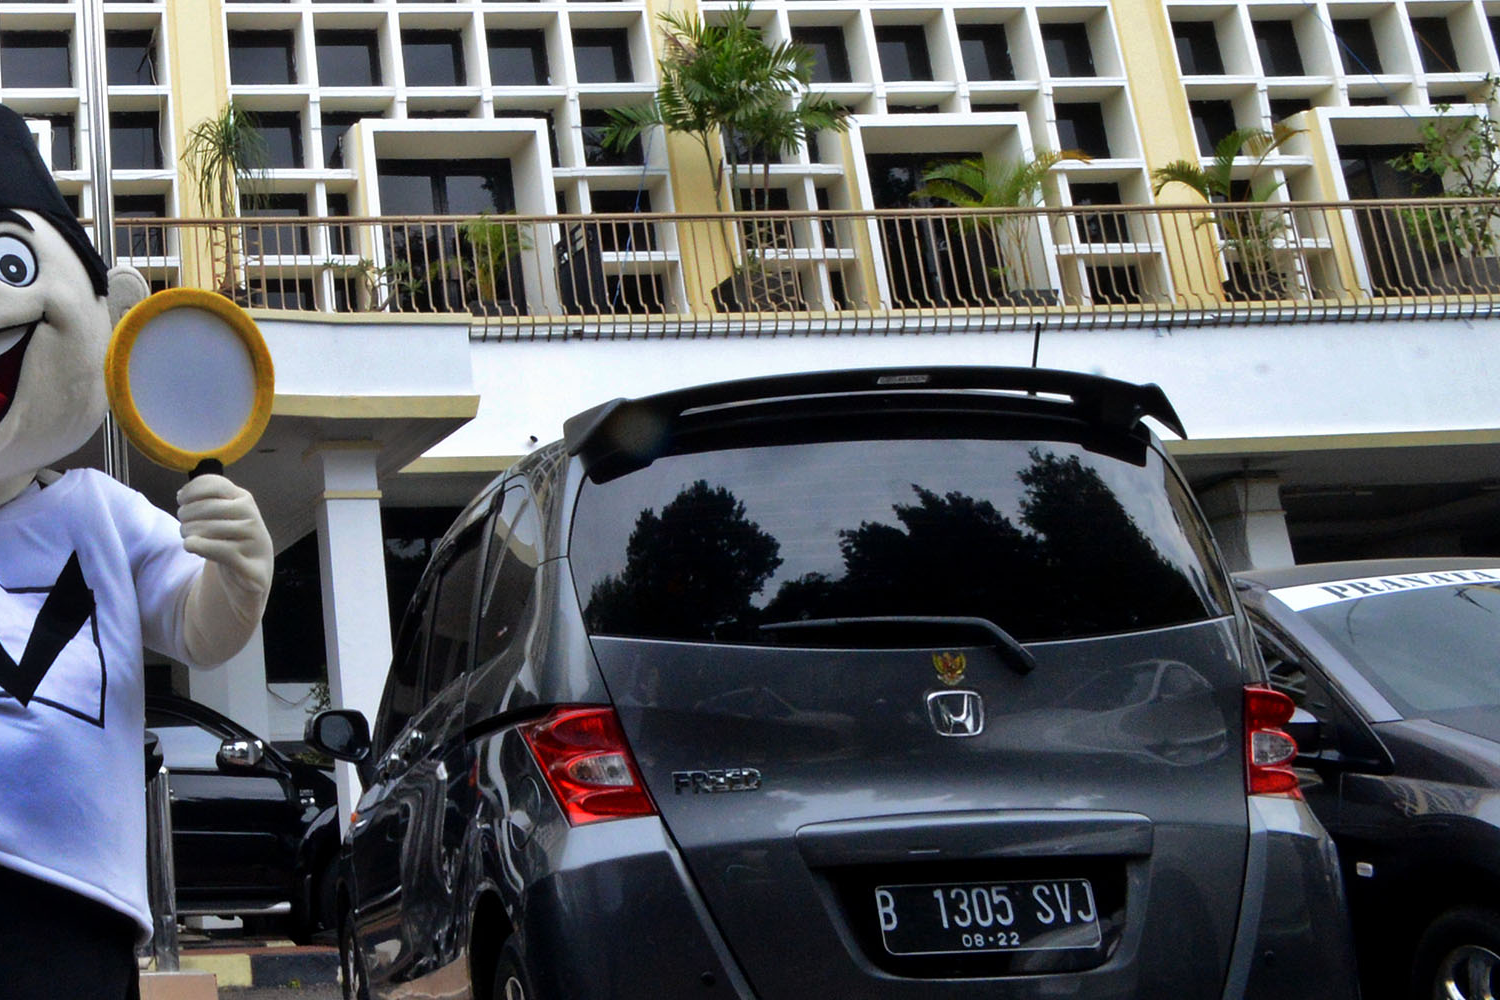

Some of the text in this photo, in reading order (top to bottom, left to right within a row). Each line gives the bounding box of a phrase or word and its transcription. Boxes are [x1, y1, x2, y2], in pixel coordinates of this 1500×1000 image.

[1318, 571, 1495, 599] PRANATA
[671, 767, 761, 795] FREED
[876, 882, 1096, 931] B 1305 SVJ
